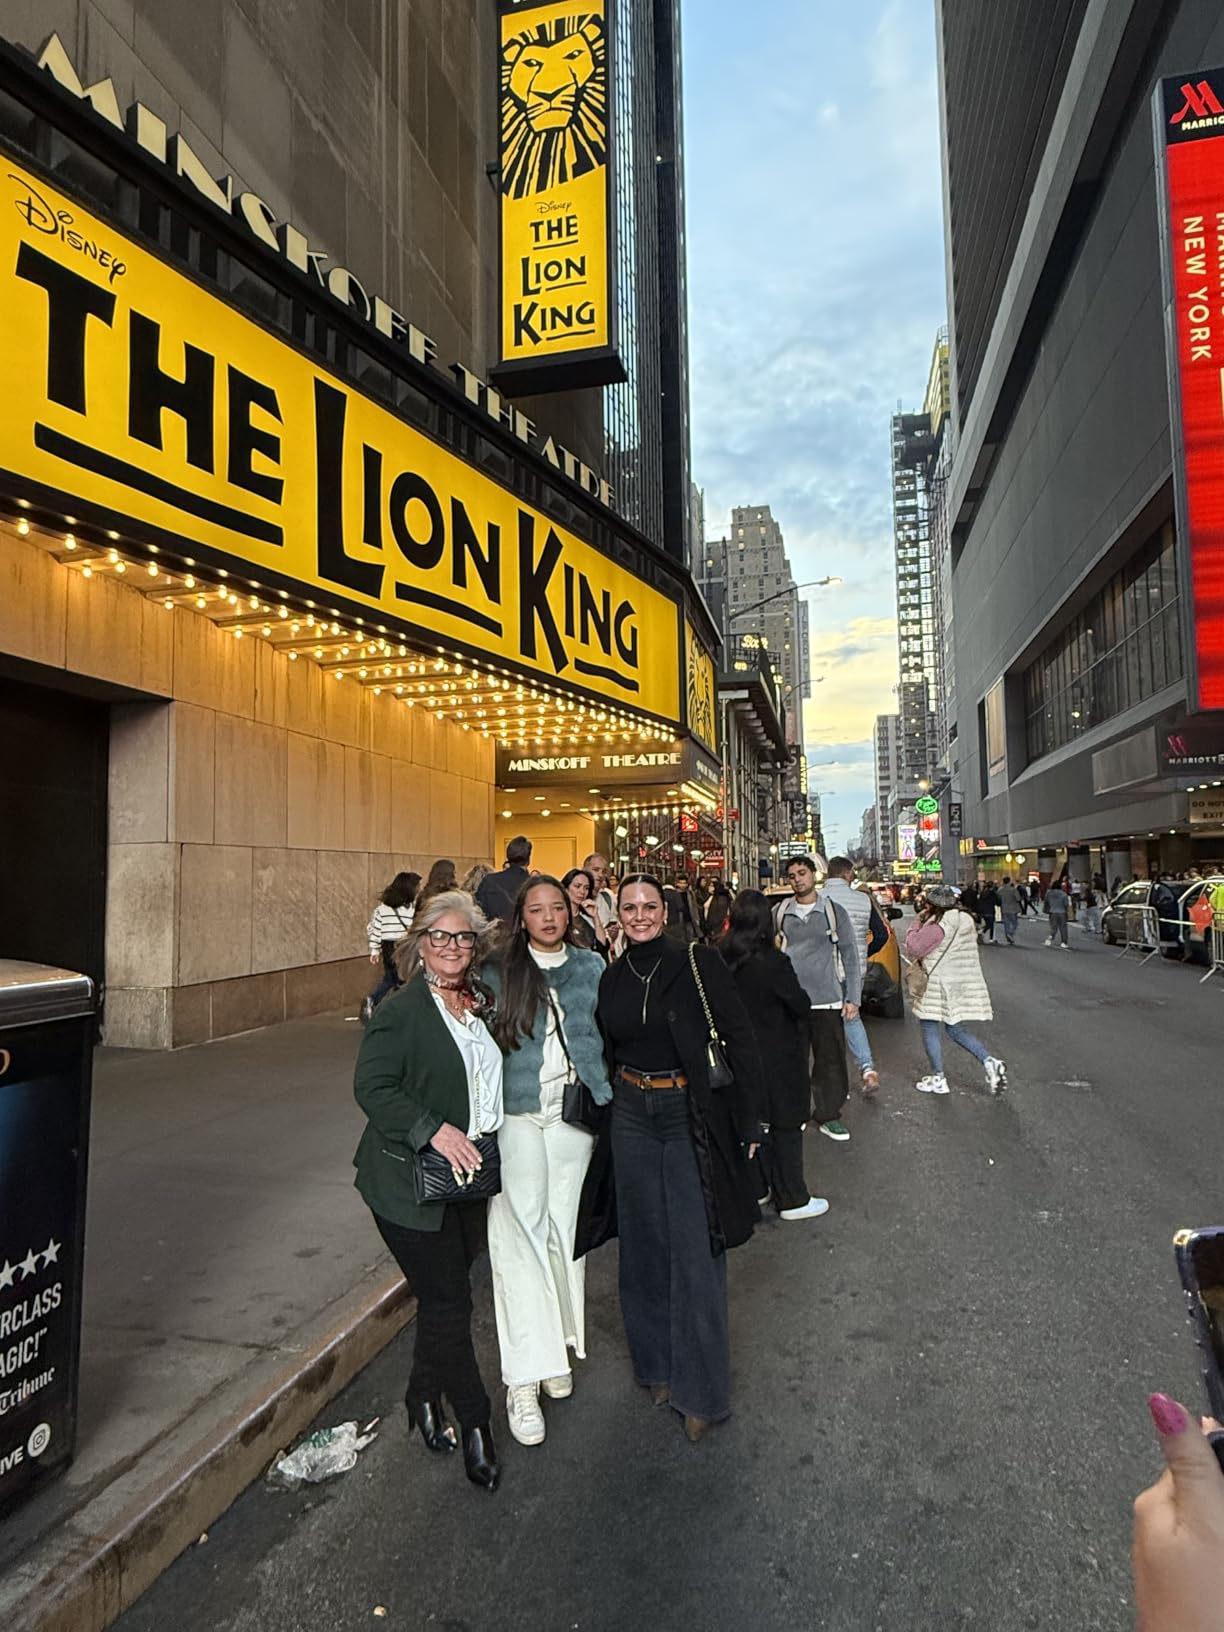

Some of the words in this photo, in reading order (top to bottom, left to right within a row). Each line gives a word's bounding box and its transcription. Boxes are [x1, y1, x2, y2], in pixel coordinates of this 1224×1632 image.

[530, 214, 579, 243] THE
[1183, 216, 1207, 275] NEW
[521, 255, 587, 297] LION
[513, 301, 596, 347] KING
[1187, 286, 1212, 361] YORK
[15, 239, 285, 507] THE
[313, 375, 502, 601] LION
[518, 506, 639, 675] KING
[508, 756, 591, 772] MINSKOFF
[601, 752, 681, 768] THEATRE
[0, 1282, 62, 1339] RCLASS
